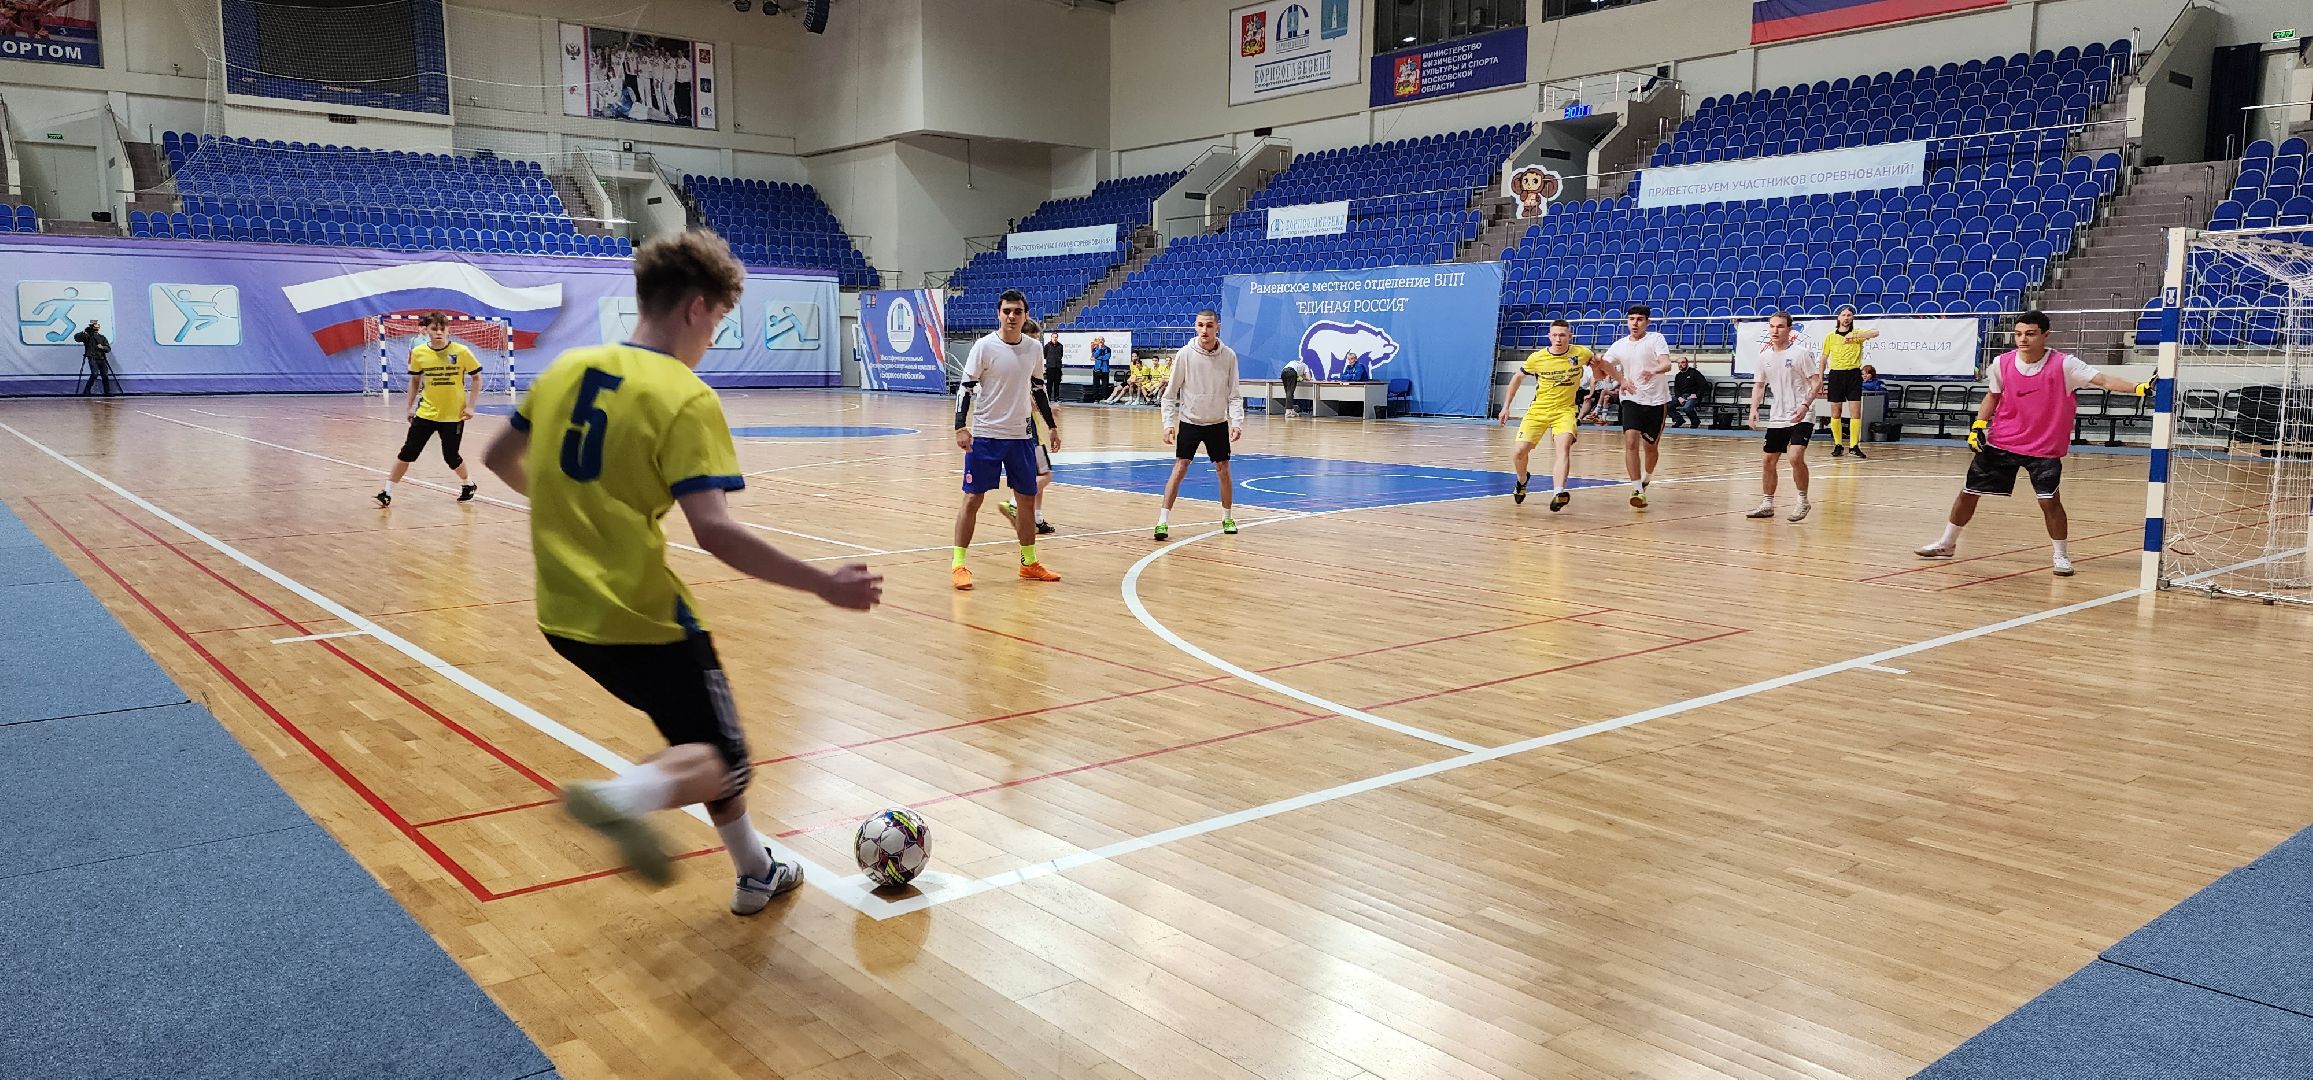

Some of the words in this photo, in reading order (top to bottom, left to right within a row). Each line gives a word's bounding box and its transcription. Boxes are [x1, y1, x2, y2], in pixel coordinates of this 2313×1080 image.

[2, 40, 82, 60] ОРТОМ
[1423, 42, 1482, 60] МИНИСТЕРСТВО
[1255, 54, 1331, 84] БОРИСОГЛЕБСКИЙ
[1422, 52, 1473, 68] ФИЗИЧЕСКОЙ
[1422, 64, 1460, 77] КУЛЬТУРЫ
[1461, 63, 1467, 71] И
[1468, 56, 1499, 69] СПОРТА
[1421, 69, 1473, 85] МОСКОВСКОЙ
[1421, 82, 1455, 94] ОБЛАСТИ
[1648, 182, 1729, 197] ПРИВЕТСТВУЕМ
[1732, 174, 1807, 191] УЧАСТНИКОВ
[1810, 162, 1915, 183] СОРЕВНОВАНИЙ!
[1250, 281, 1310, 295] Раменское
[1311, 280, 1362, 292] местное
[1364, 277, 1431, 290] отделение
[1434, 272, 1466, 287] ВПП
[1296, 300, 1351, 316] "ЕДИНАЯ
[1353, 297, 1409, 313] РОССИЯ"
[1889, 341, 1952, 351] ФЕДЕРАЦИЯ
[560, 367, 624, 483] 5
